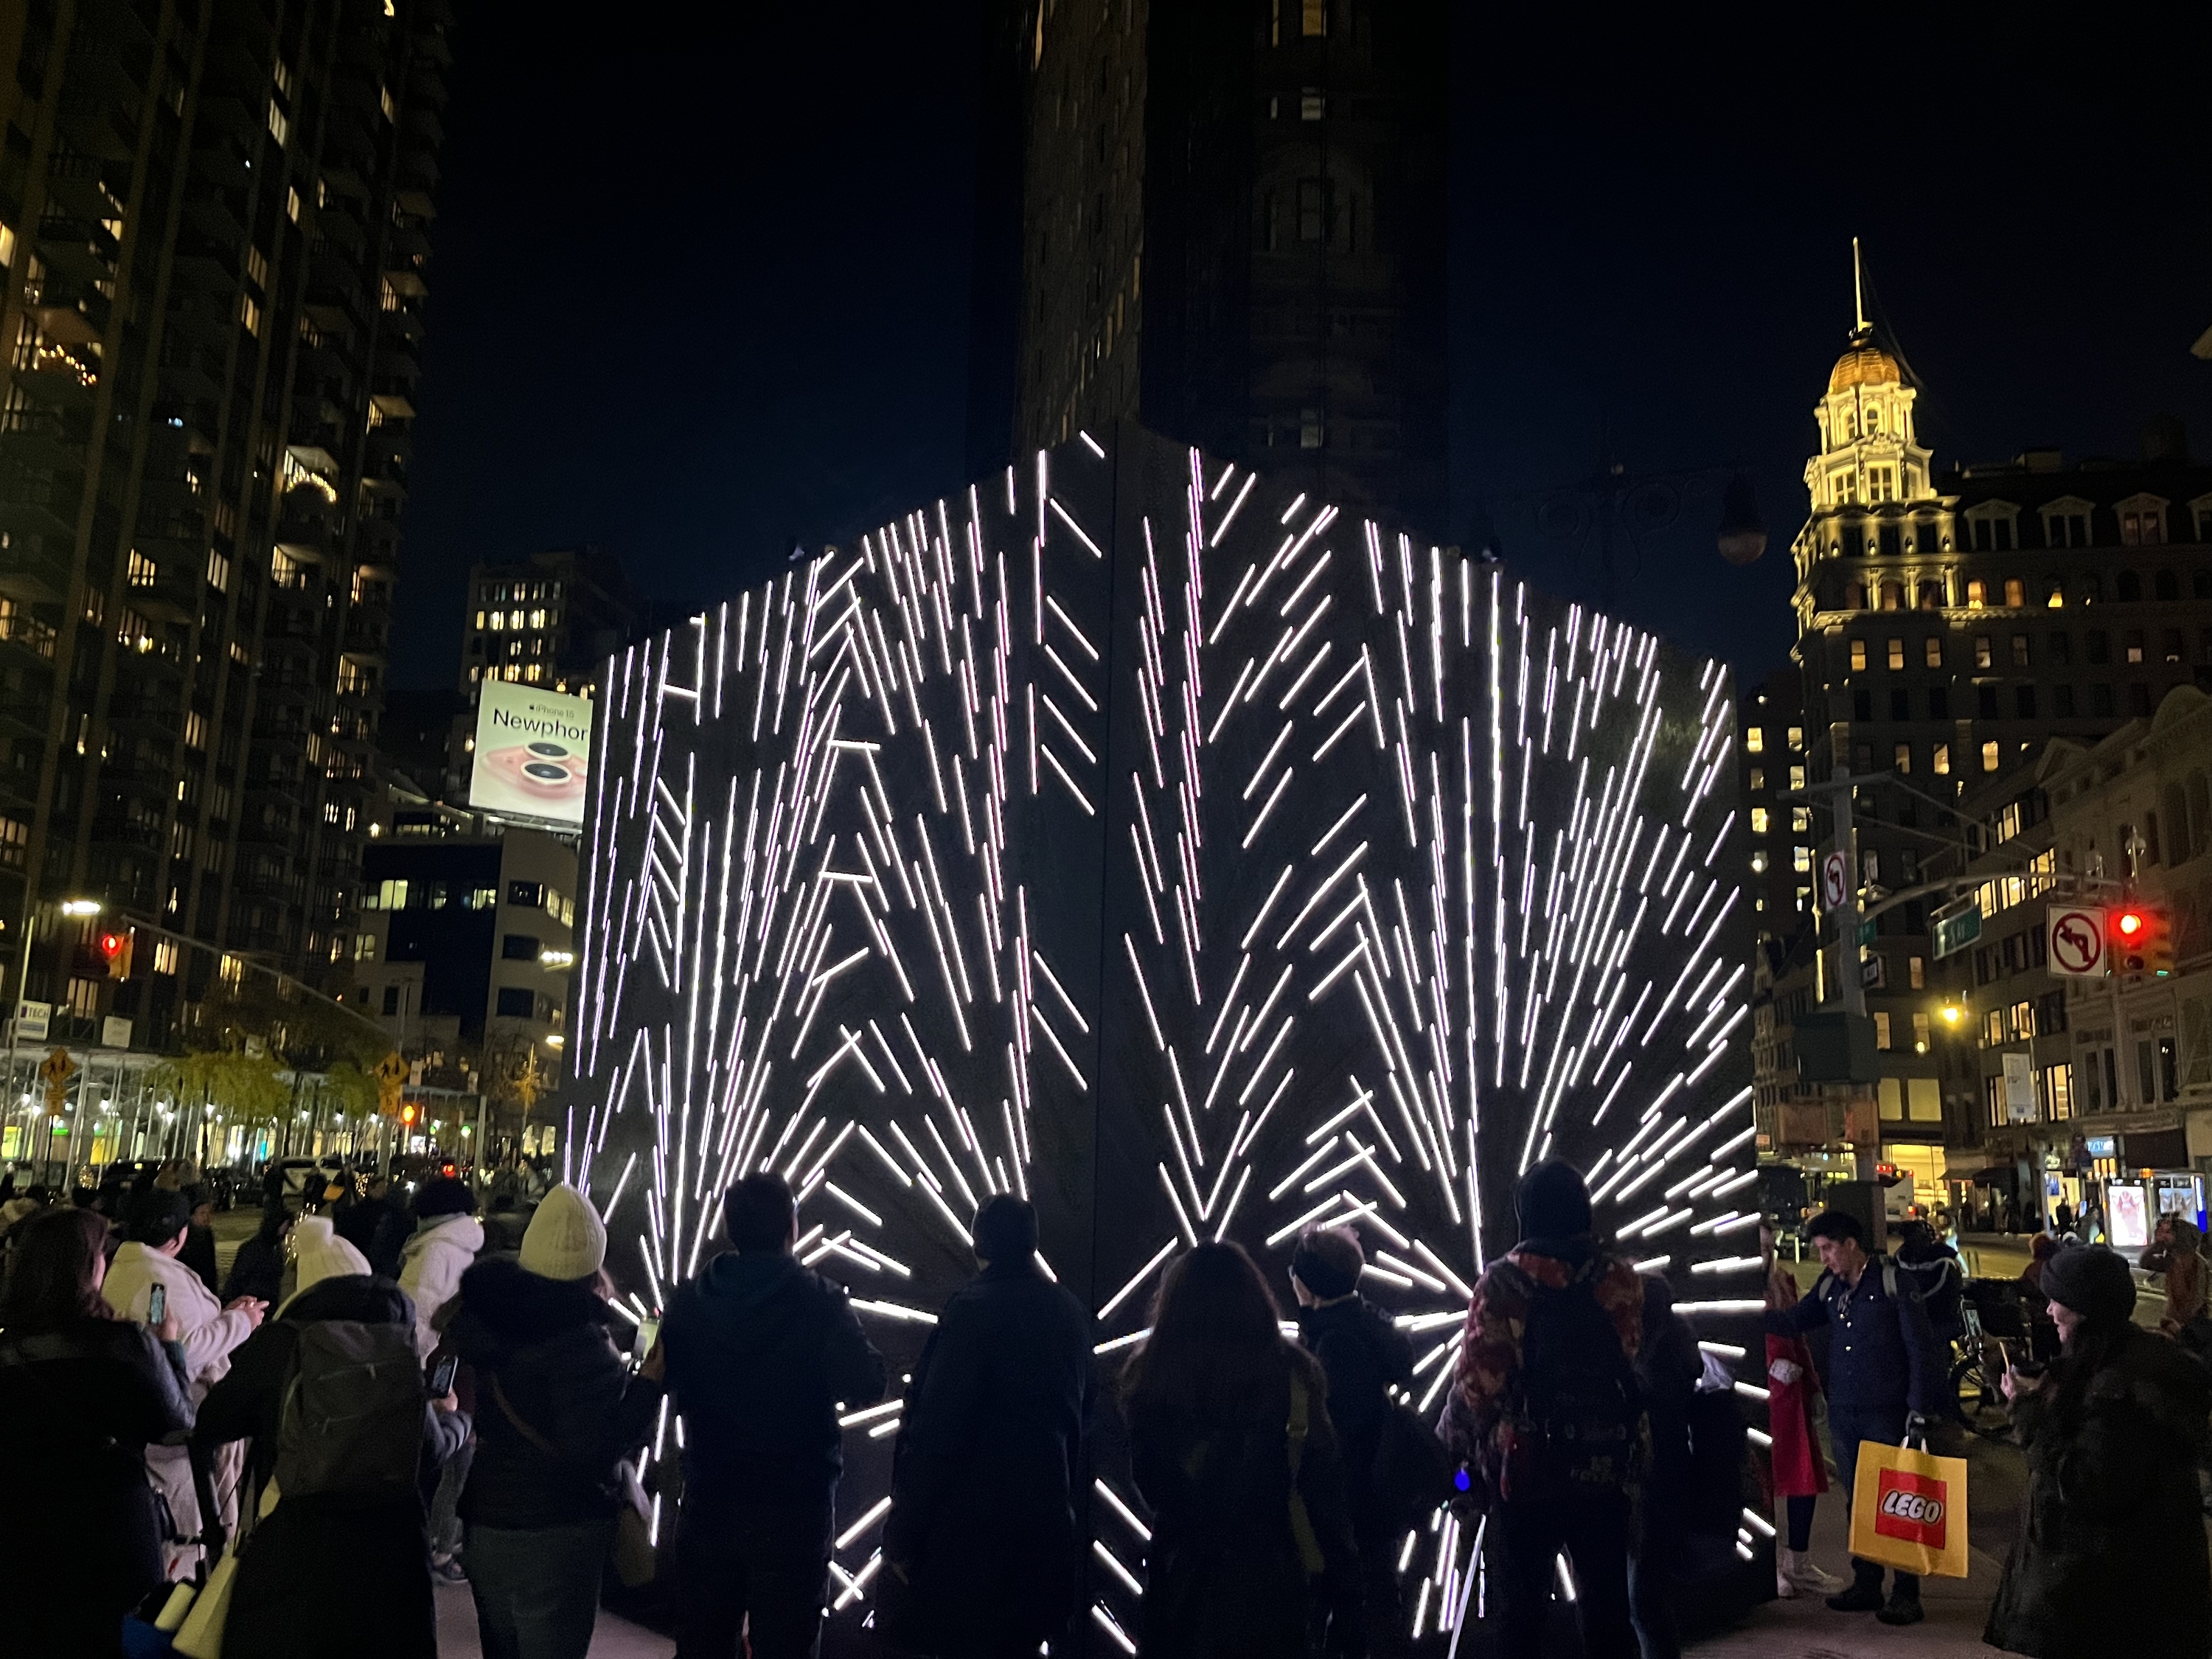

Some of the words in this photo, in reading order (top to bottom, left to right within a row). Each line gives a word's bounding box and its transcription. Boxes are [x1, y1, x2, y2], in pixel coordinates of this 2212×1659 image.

[493, 708, 588, 740] Newphor
[536, 704, 565, 716] iPhone
[1882, 1490, 1941, 1523] LEGO
